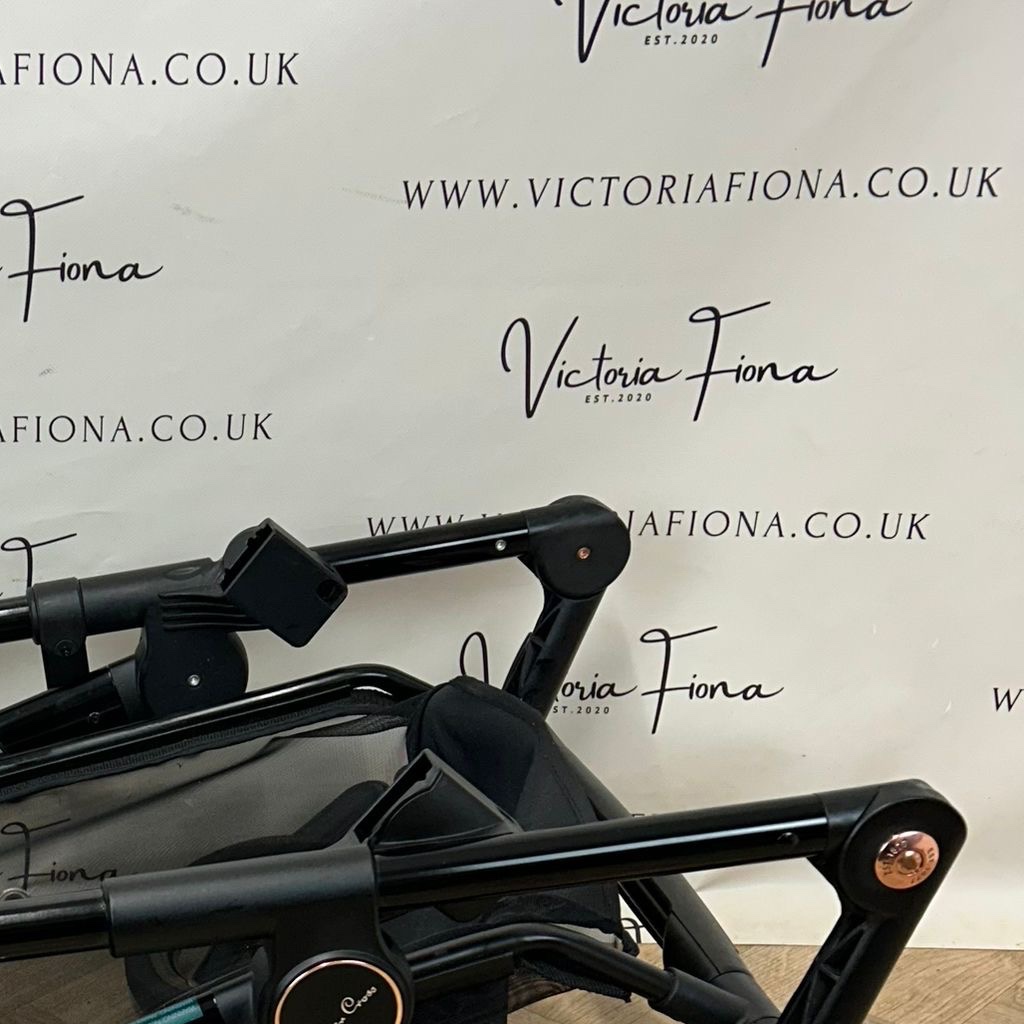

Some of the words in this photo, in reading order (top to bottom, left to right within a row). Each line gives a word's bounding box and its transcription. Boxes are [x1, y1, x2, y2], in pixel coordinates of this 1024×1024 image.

[644, 33, 719, 46] EST.2020
[403, 167, 1002, 210] WWW.VICTORIAFIONA.CO.UK
[0, 195, 163, 323] Fiona
[501, 316, 682, 419] Victoria
[685, 301, 838, 422] Fiona
[584, 392, 652, 404] EST.2020
[640, 626, 784, 734] Fiona
[552, 705, 610, 715] ST.2020
[340, 986, 377, 1014] Cross
